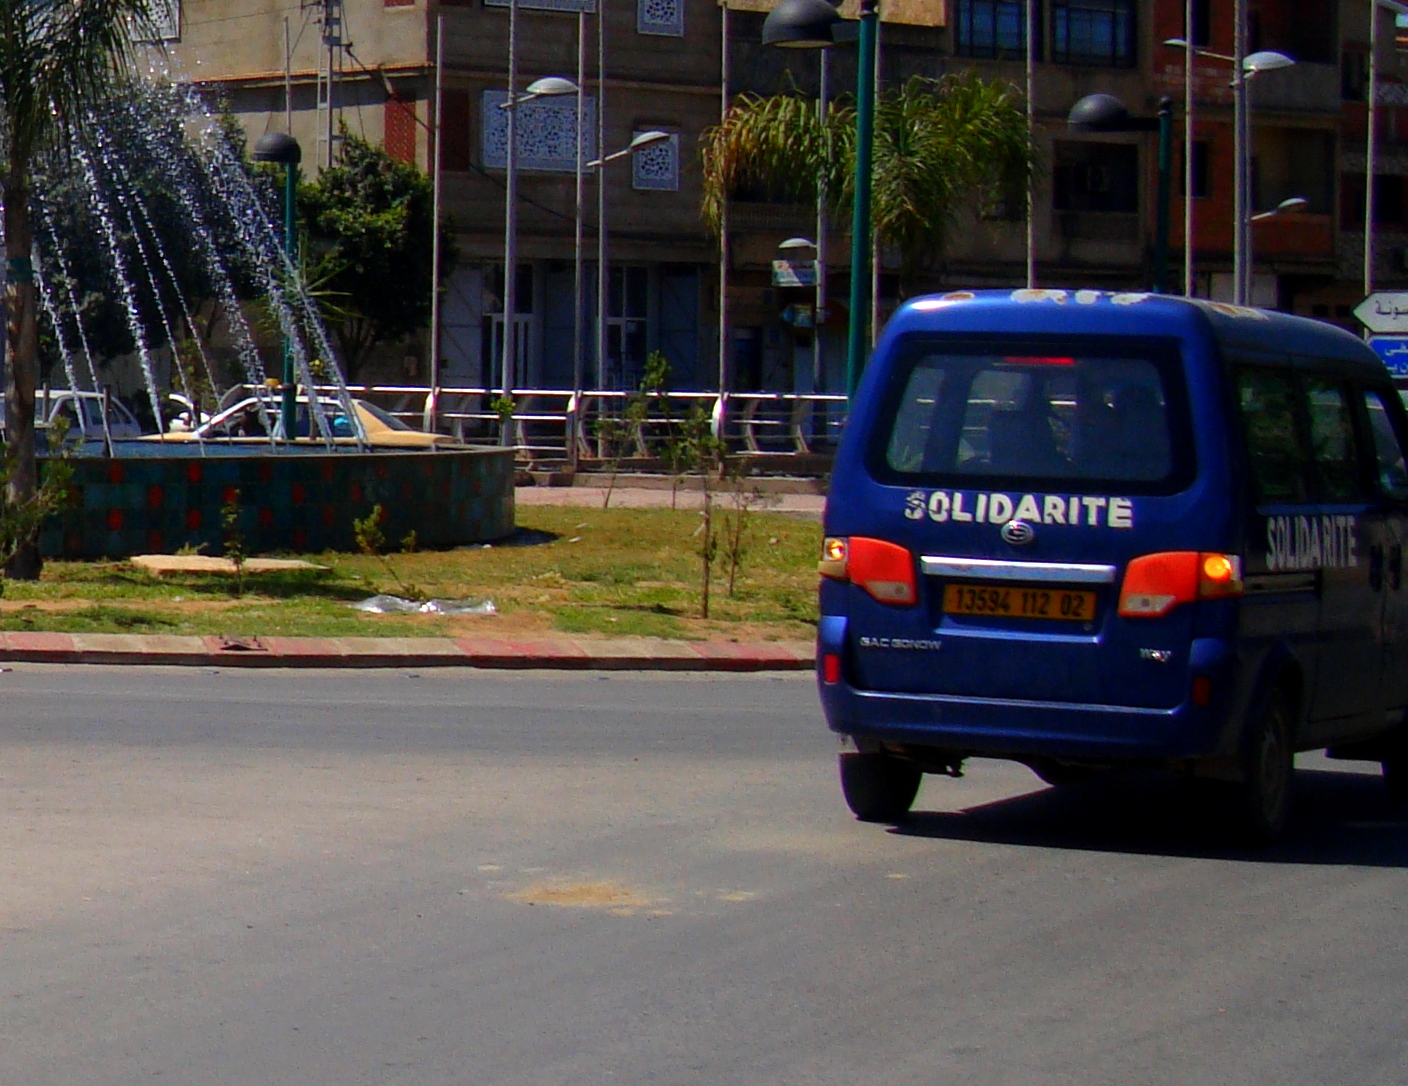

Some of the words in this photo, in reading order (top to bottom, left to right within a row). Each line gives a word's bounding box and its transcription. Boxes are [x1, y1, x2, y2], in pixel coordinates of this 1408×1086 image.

[904, 490, 1134, 529] SOLIDARITE
[1265, 514, 1357, 571] SOLIDARITE
[956, 587, 1011, 615] 13594
[1021, 592, 1049, 616] 112
[1060, 594, 1086, 616] 02
